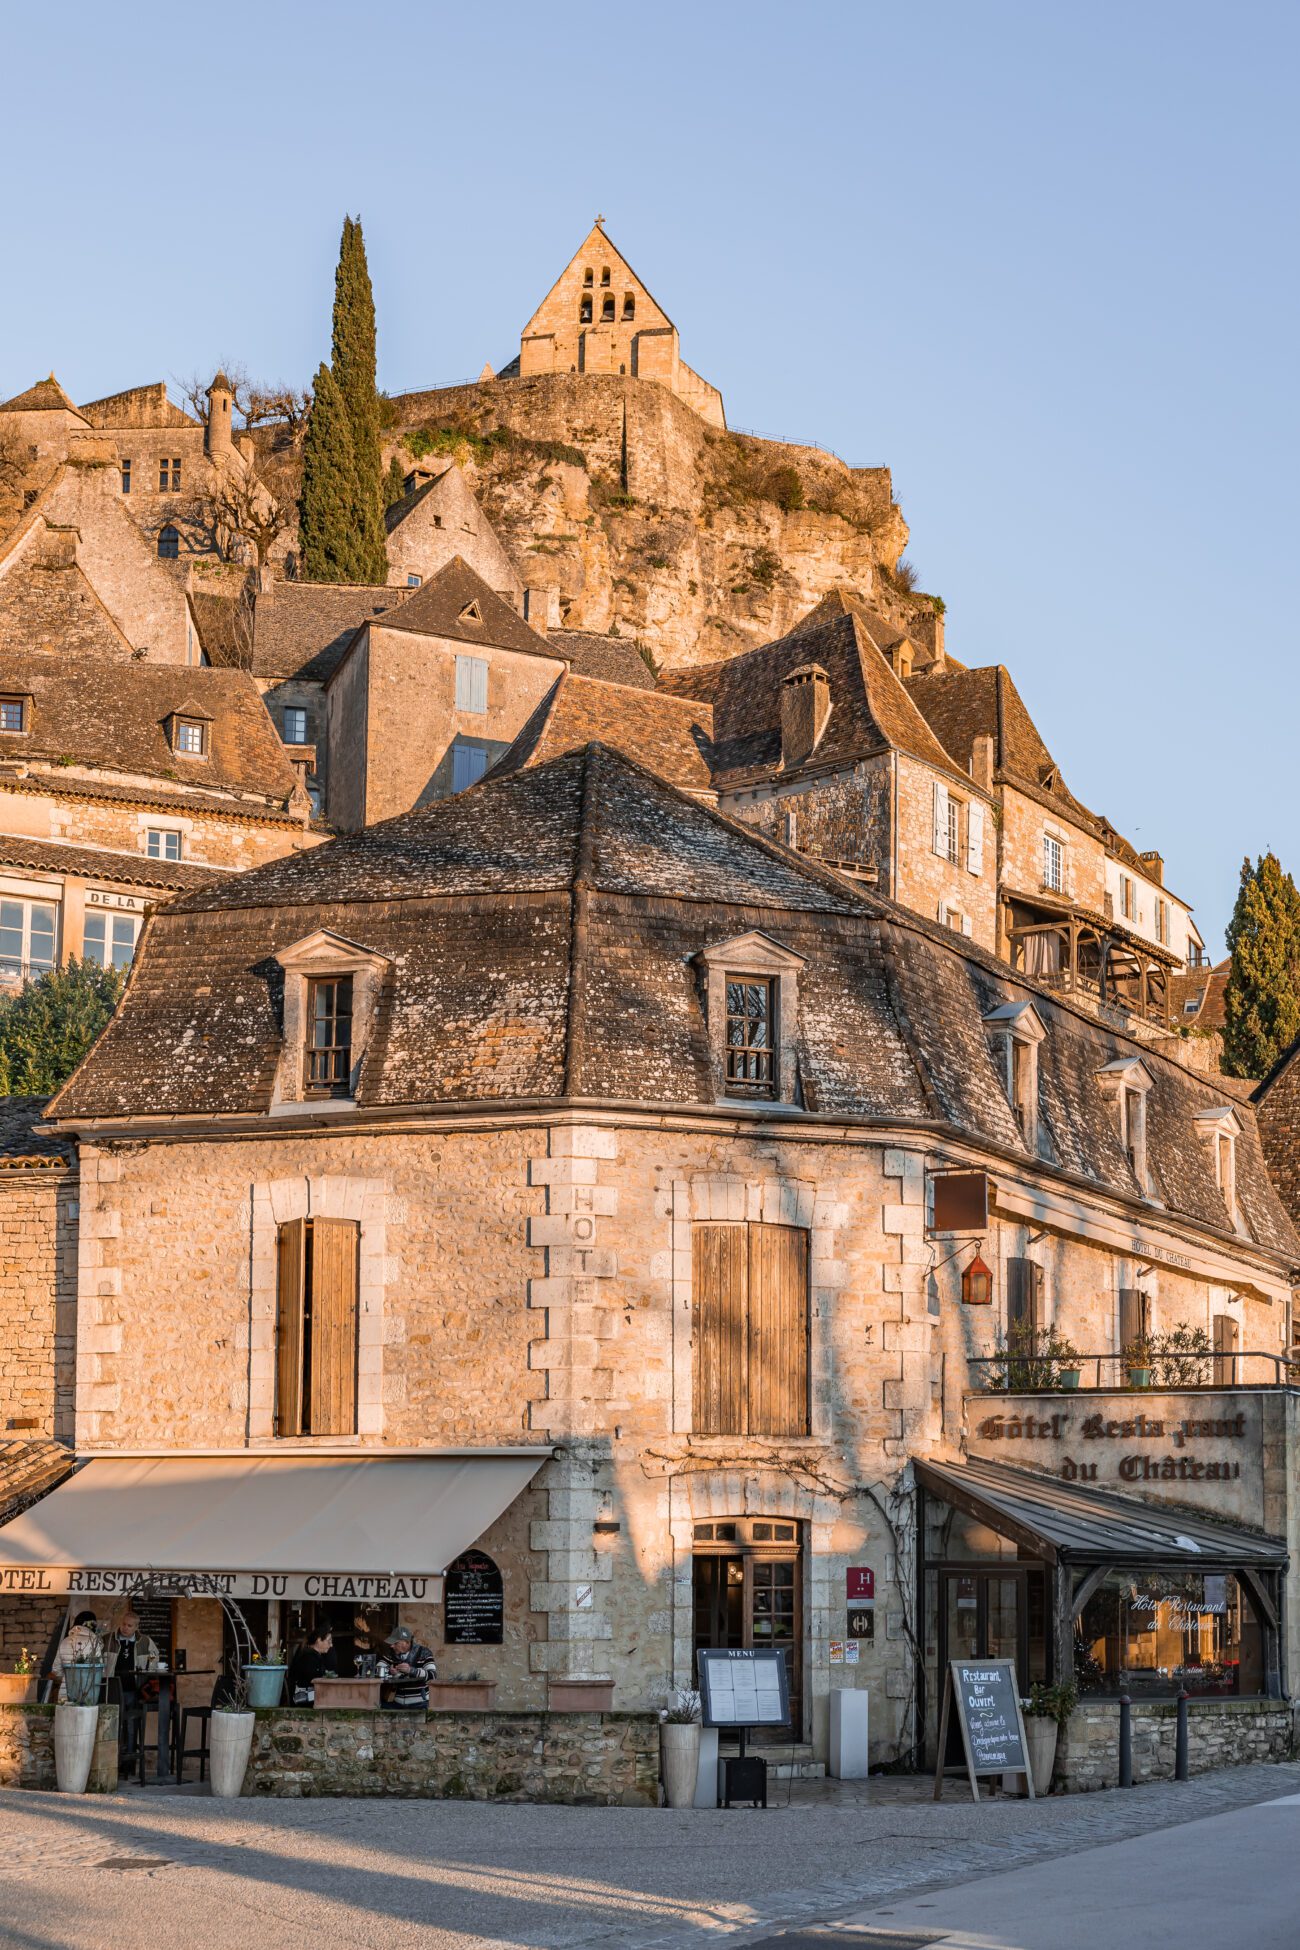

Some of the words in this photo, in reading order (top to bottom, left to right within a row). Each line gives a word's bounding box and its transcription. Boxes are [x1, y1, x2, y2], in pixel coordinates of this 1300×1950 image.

[91, 893, 110, 904] DE
[118, 897, 135, 908] LA
[1062, 1456, 1098, 1481] du
[66, 1570, 236, 1595] RESTAURANT
[251, 1575, 289, 1596] DU
[304, 1576, 428, 1599] CHATEAU
[859, 1572, 871, 1585] H
[963, 1669, 1001, 1682] Restaurant
[974, 1685, 986, 1694] Bar
